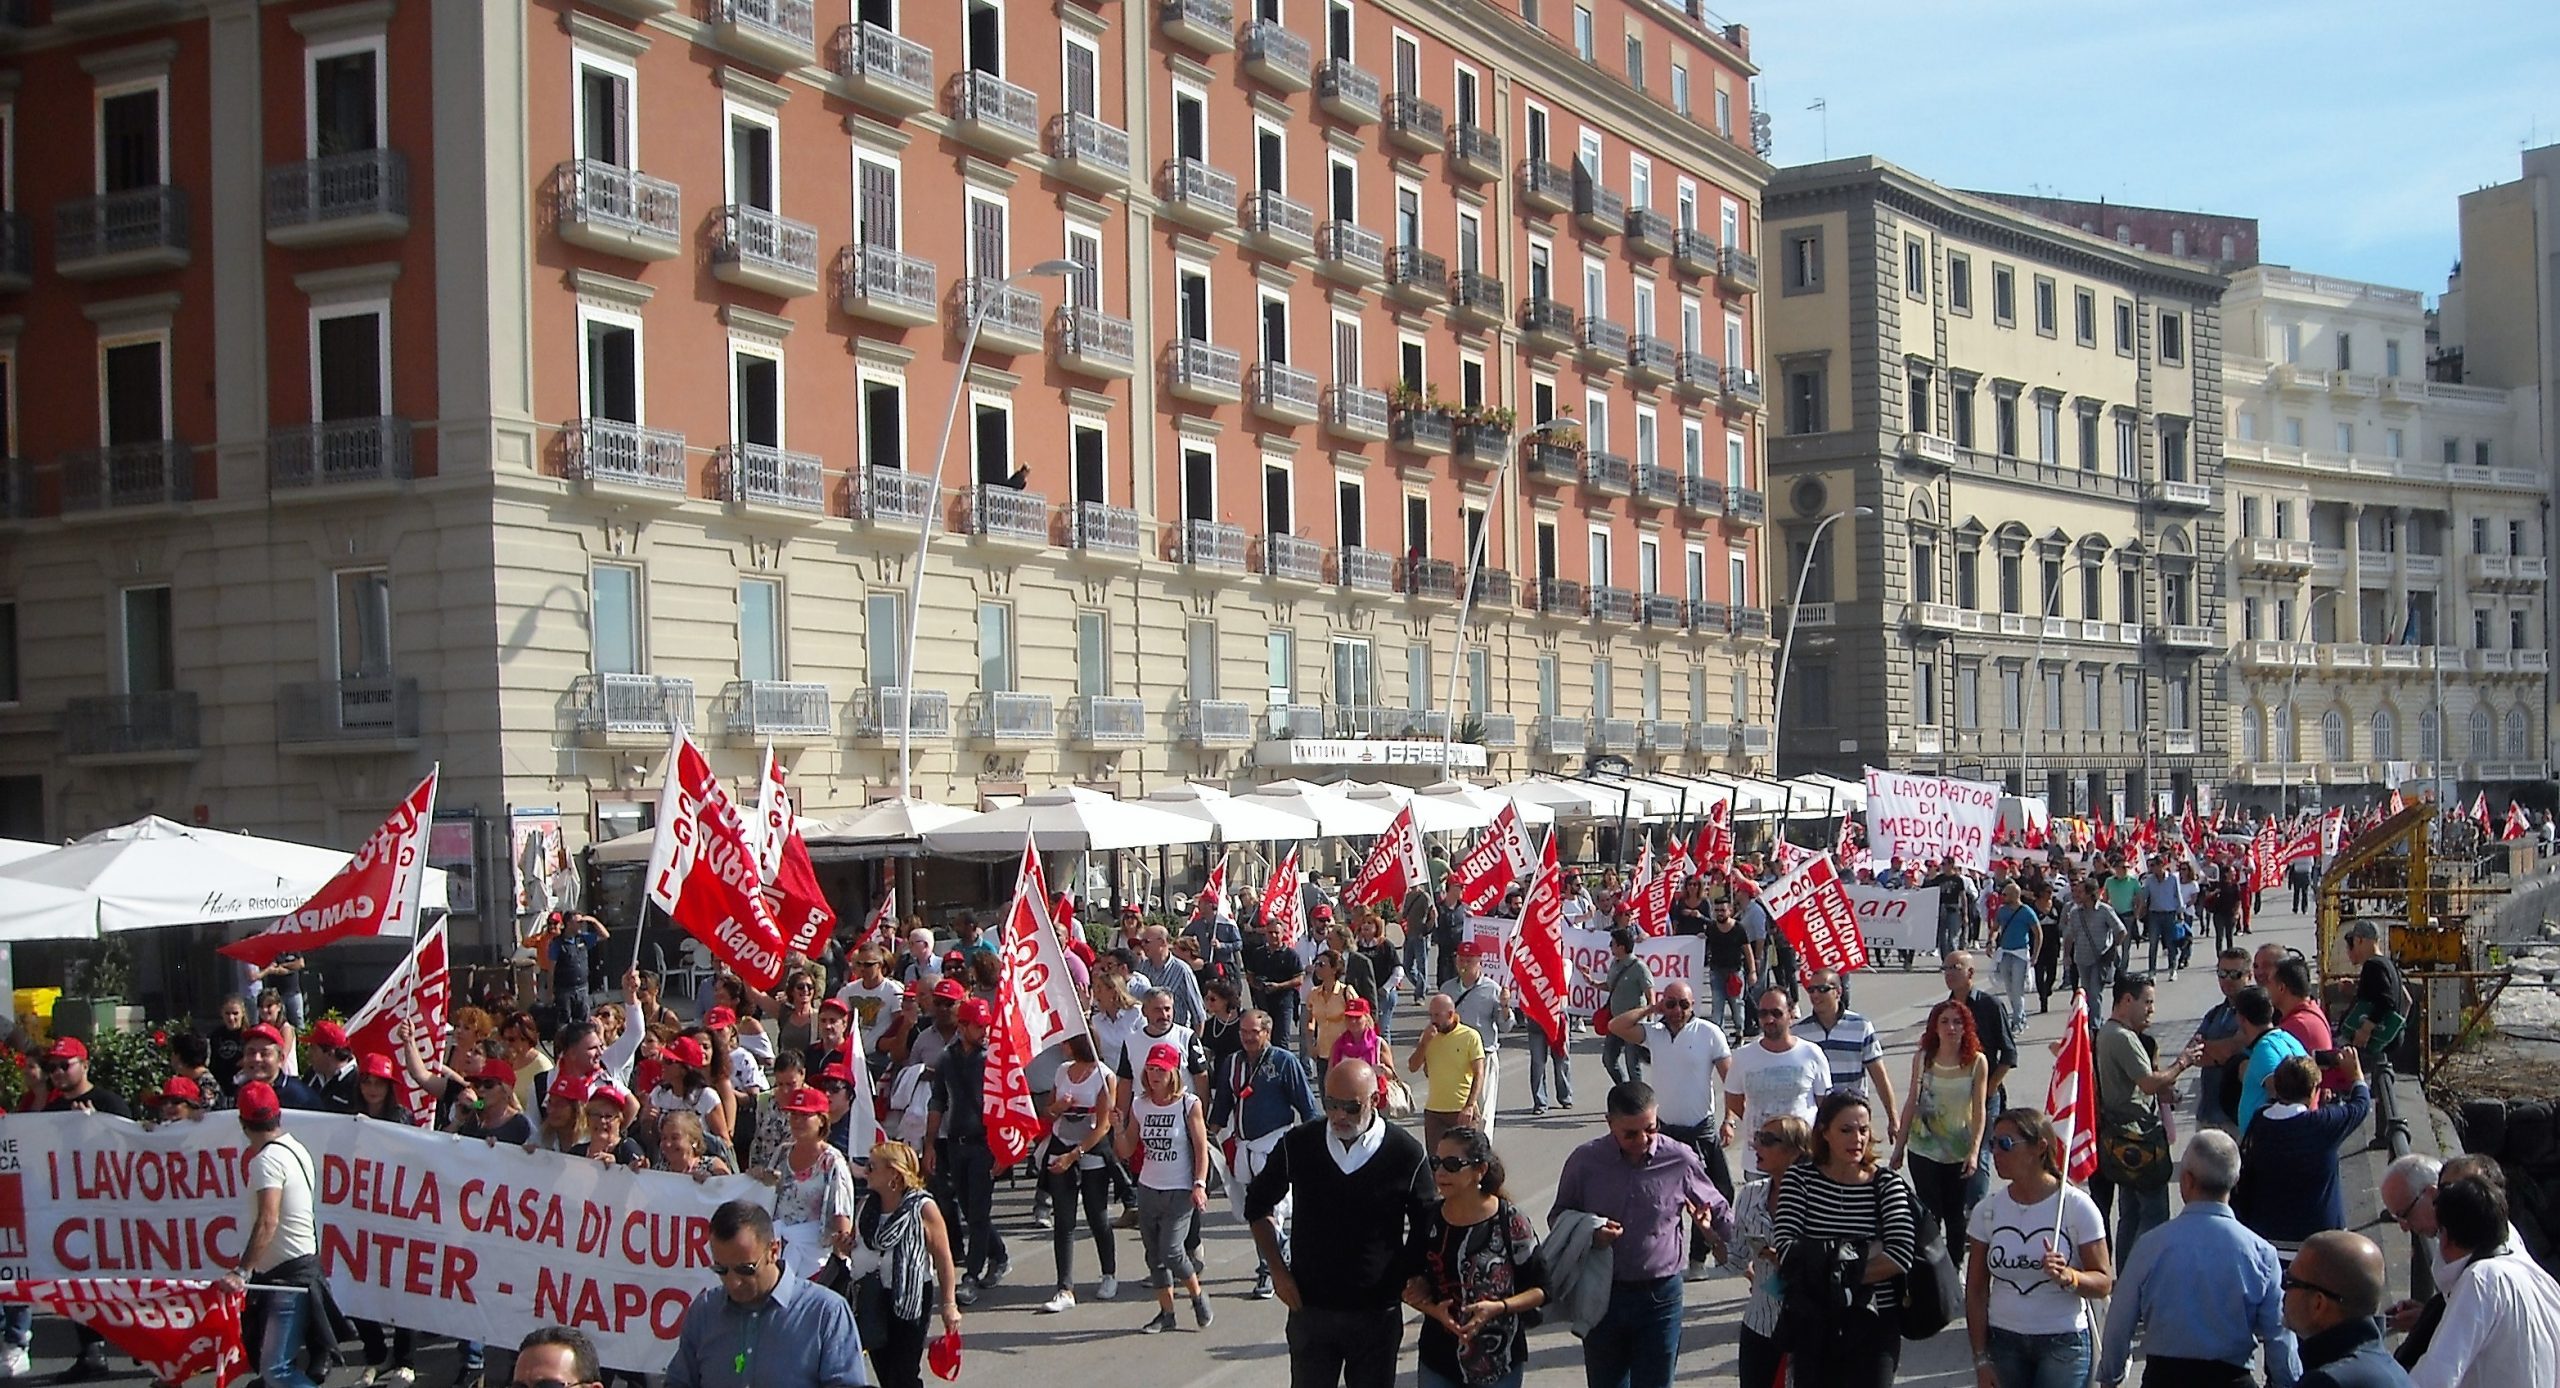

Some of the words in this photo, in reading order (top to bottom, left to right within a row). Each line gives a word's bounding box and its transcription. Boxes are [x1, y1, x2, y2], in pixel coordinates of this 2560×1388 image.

[1867, 773, 1880, 798] I
[1920, 802, 1936, 815] DI
[657, 793, 693, 901] CGIL
[1769, 874, 1812, 913] CGIL
[1818, 881, 1865, 967] FUNZIONE
[714, 915, 782, 980] Napoli
[1481, 952, 1500, 962] GIL
[1143, 1129, 1168, 1137] LAZY
[1145, 1114, 1175, 1127] LOVELY
[48, 1151, 60, 1200] I
[321, 1154, 442, 1225] DELLA
[459, 1178, 564, 1249] CASA
[576, 1199, 612, 1258] DI
[621, 1210, 712, 1269] CUR
[1989, 1245, 2044, 1270] Quee
[0, 1266, 30, 1281] OLI
[53, 1216, 241, 1272] CLINIC
[320, 1223, 478, 1305] NTER
[534, 1266, 694, 1341] NAPO
